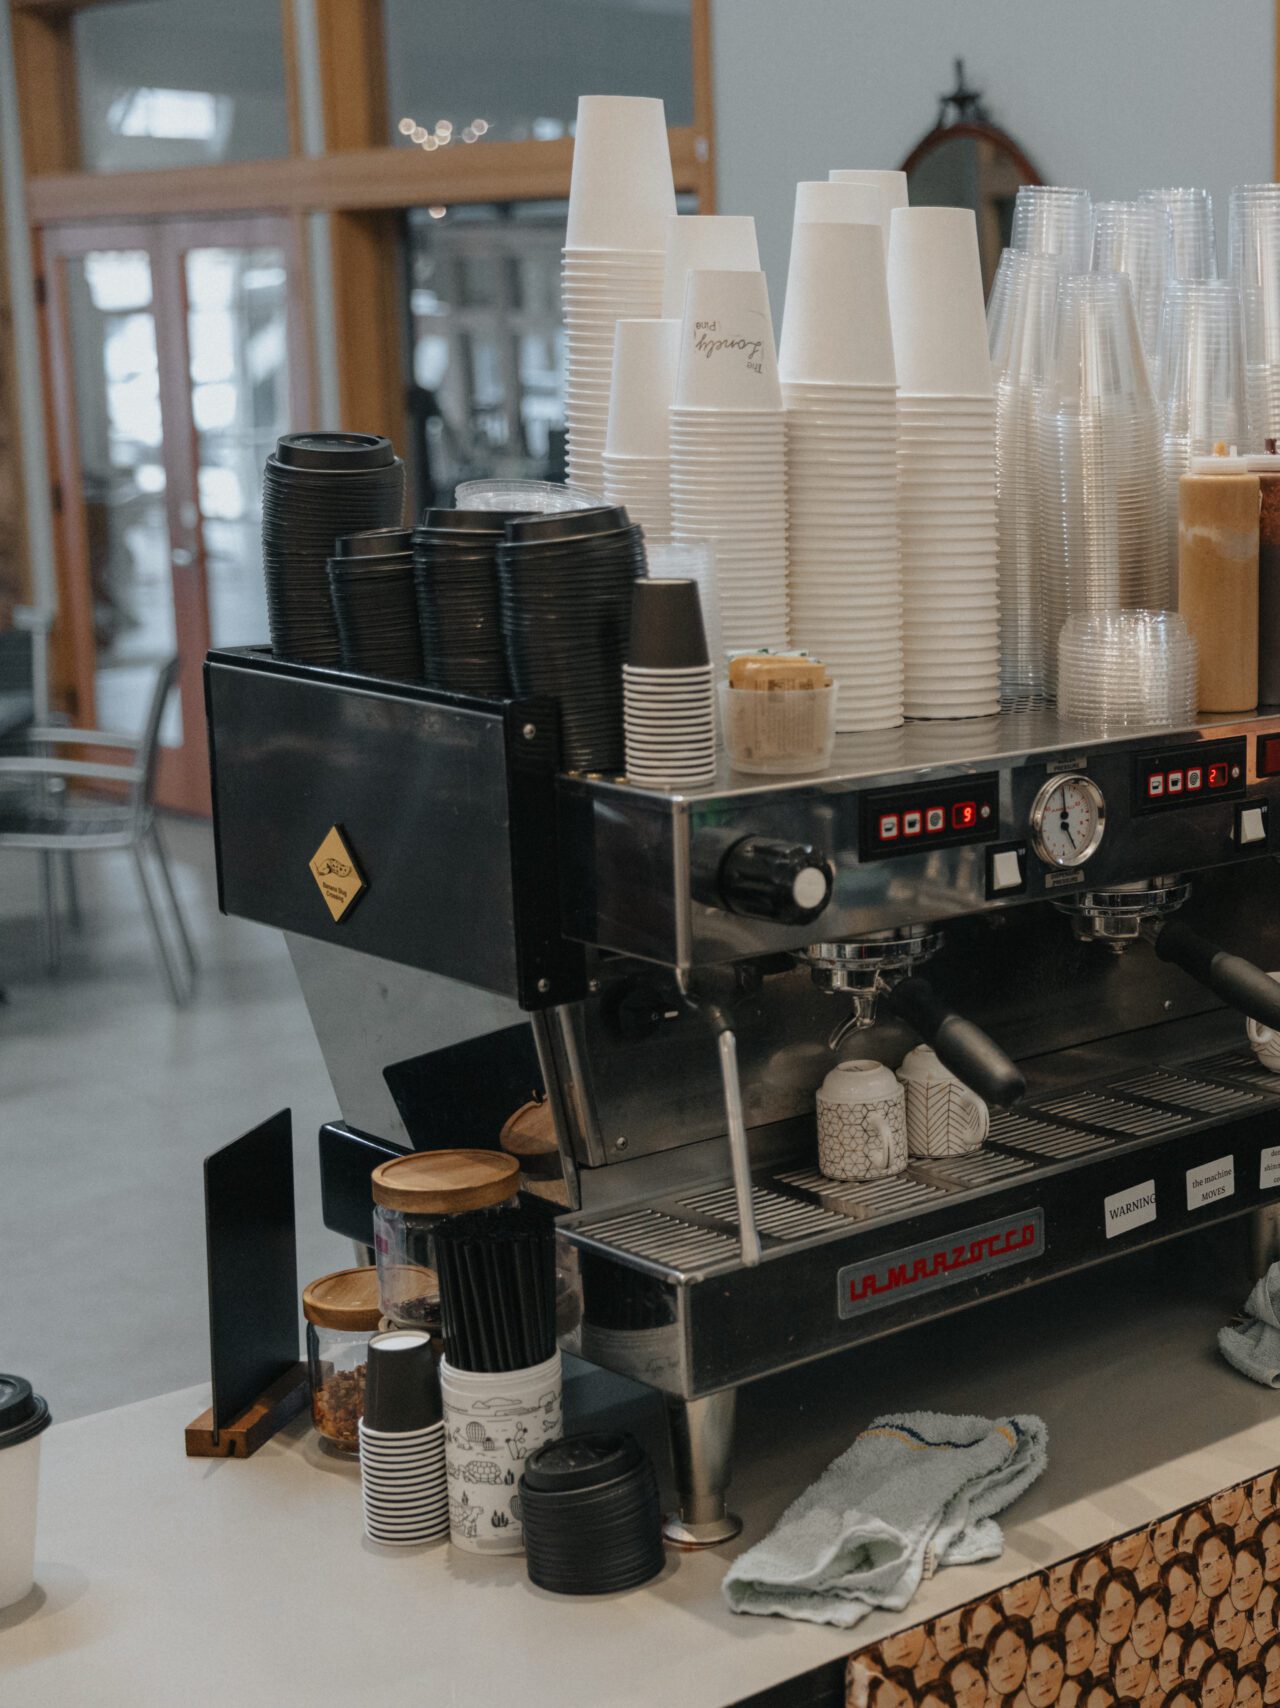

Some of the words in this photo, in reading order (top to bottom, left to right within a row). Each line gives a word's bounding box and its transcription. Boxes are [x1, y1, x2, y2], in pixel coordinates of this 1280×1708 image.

[695, 333, 762, 359] Lonely
[746, 361, 763, 374] The
[1192, 1178, 1204, 1189] the
[1204, 1168, 1232, 1185] machine
[1201, 1185, 1226, 1202] MOVES
[1109, 1193, 1156, 1220] WARNING
[888, 1223, 1035, 1288] MARZOCCO
